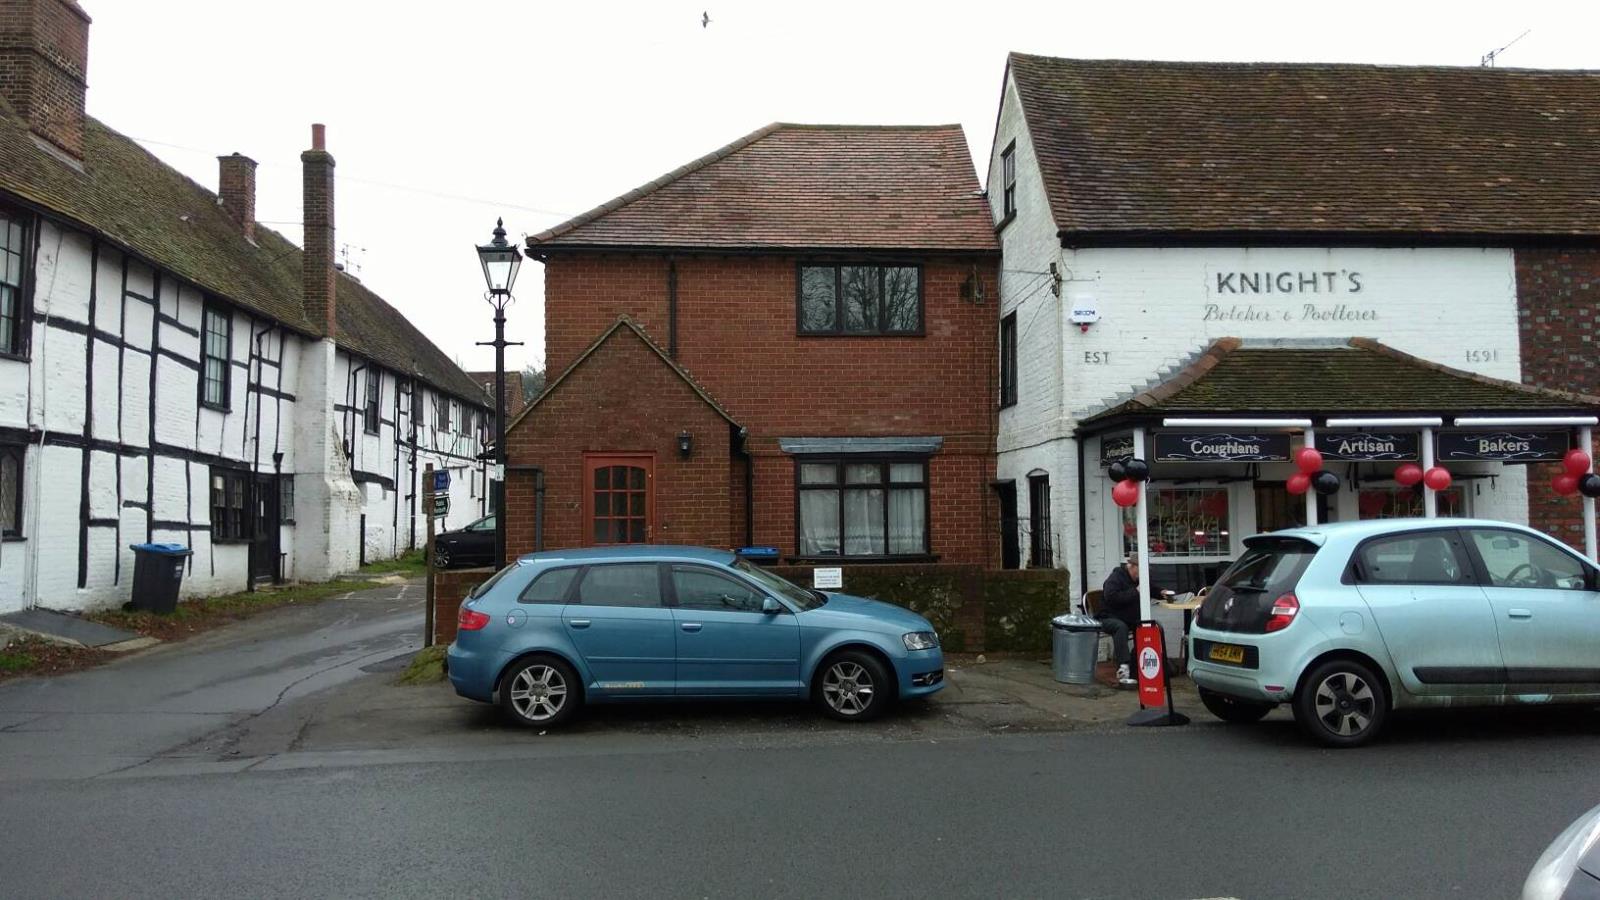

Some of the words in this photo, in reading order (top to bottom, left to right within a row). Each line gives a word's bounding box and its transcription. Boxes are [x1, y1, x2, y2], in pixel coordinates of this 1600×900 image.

[1217, 269, 1363, 294] KNIGHT'S
[1085, 351, 1109, 364] EST
[1466, 349, 1496, 362] 1591
[1190, 441, 1260, 457] Coughlans
[1338, 440, 1395, 454] Artisan
[1479, 439, 1530, 453] Bakers
